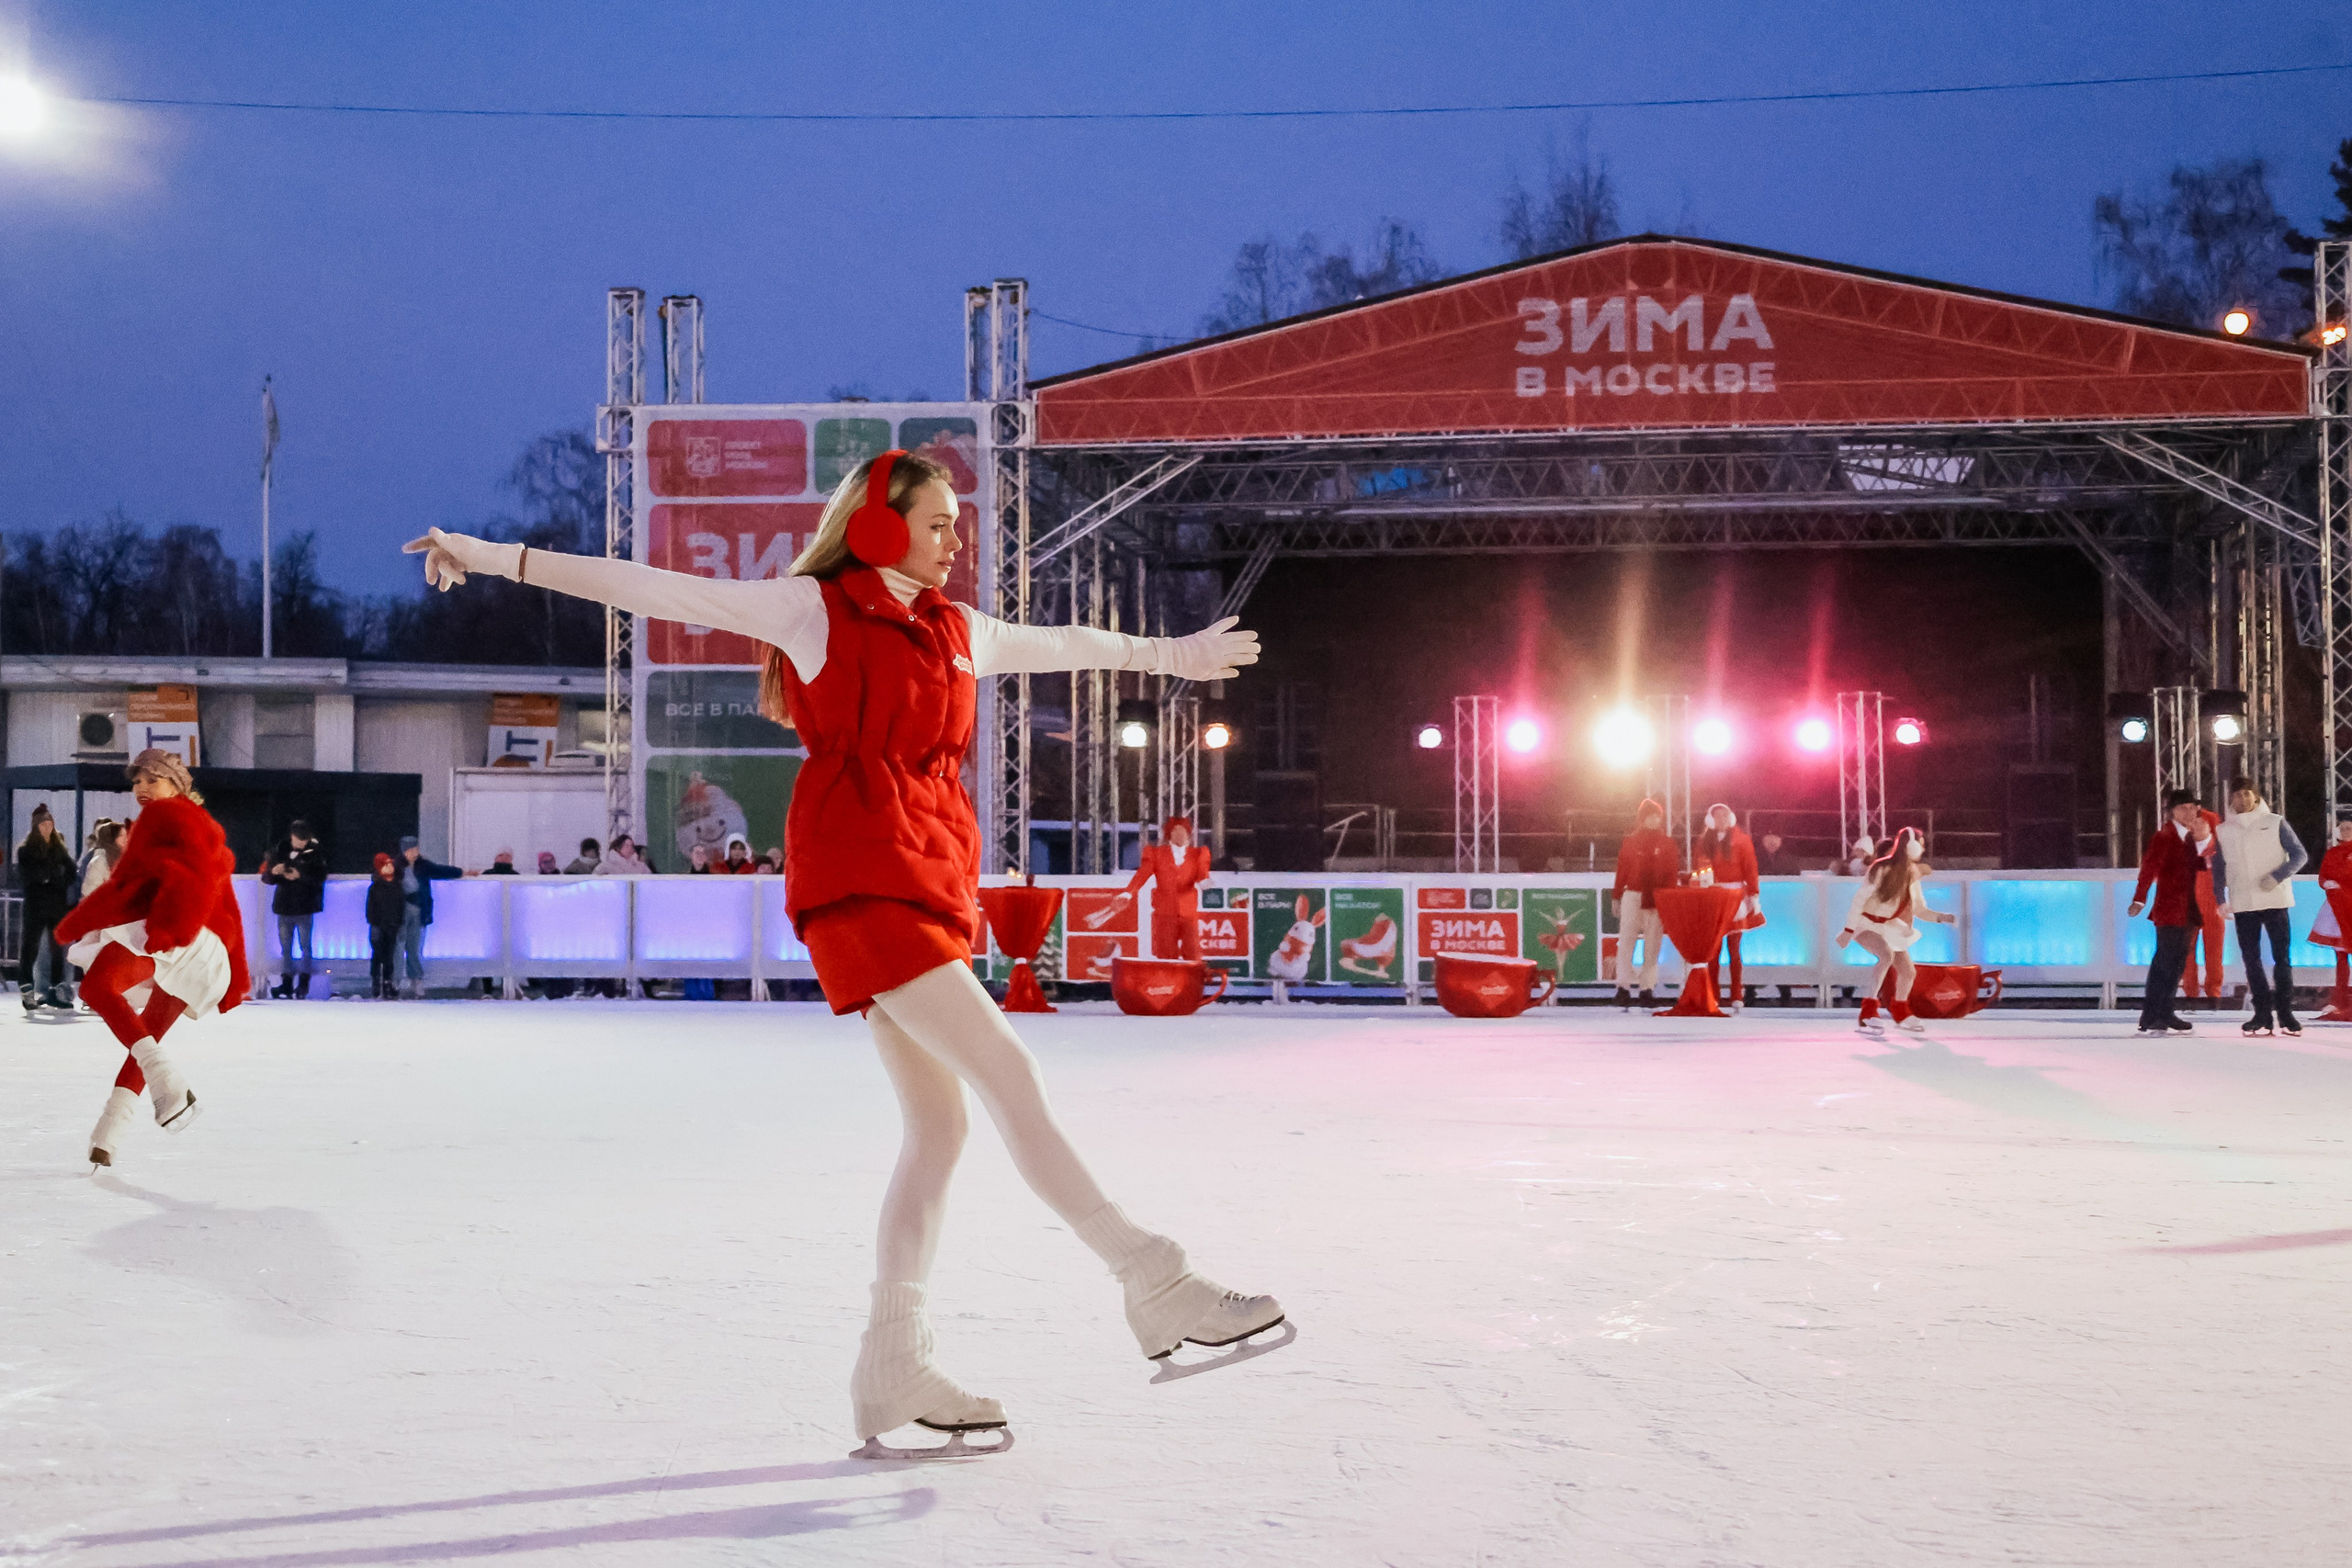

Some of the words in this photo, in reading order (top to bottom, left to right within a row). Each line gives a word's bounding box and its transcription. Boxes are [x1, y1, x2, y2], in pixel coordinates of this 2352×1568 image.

[1515, 293, 1775, 355] ЗИМА
[1516, 367, 1546, 398] В
[1566, 362, 1777, 397] МОСКВЕ
[685, 532, 816, 581] ЗИ
[665, 703, 705, 716] ВСЕ
[709, 703, 723, 716] В
[728, 703, 759, 716] ПА
[1197, 919, 1237, 937] МА
[1430, 919, 1506, 938] ЗИМА
[1199, 939, 1237, 950] СКВЕ
